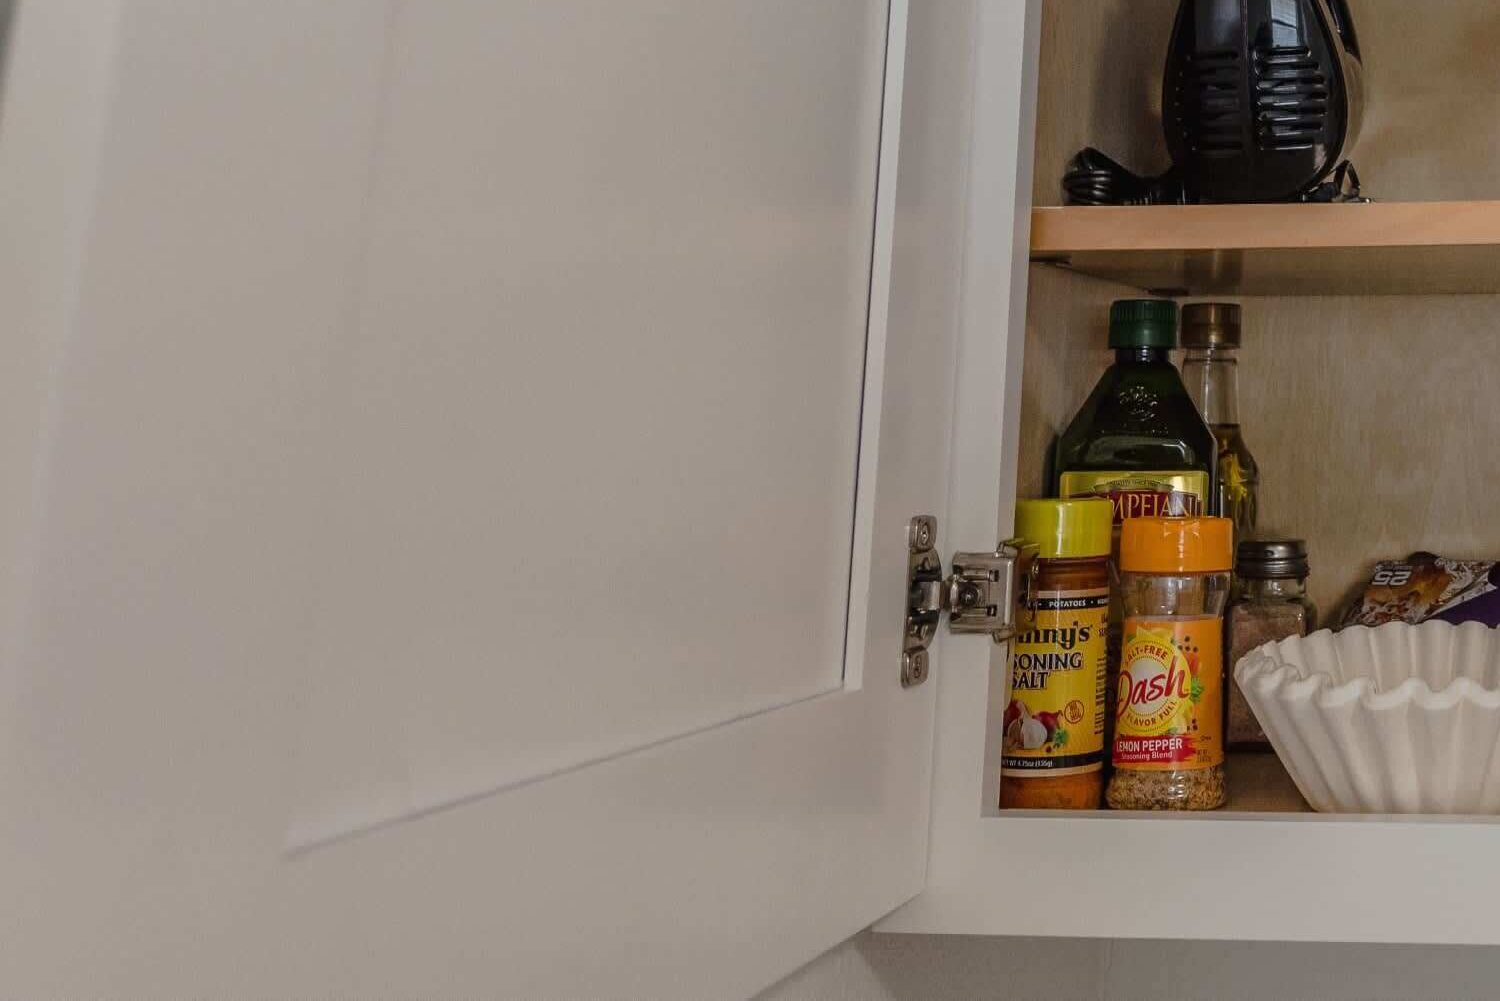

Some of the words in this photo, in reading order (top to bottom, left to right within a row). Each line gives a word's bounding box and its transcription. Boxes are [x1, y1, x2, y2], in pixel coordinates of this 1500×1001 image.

[1371, 570, 1412, 586] 25
[1048, 599, 1086, 608] POTATOES
[1117, 656, 1190, 718] Dash
[1126, 712, 1157, 727] FLAVOR
[1158, 700, 1178, 721] FULL
[1116, 740, 1140, 752] LEMON
[1142, 738, 1183, 751] PEPPER
[1121, 751, 1150, 761] Seasoning
[1151, 751, 1174, 759] Blend
